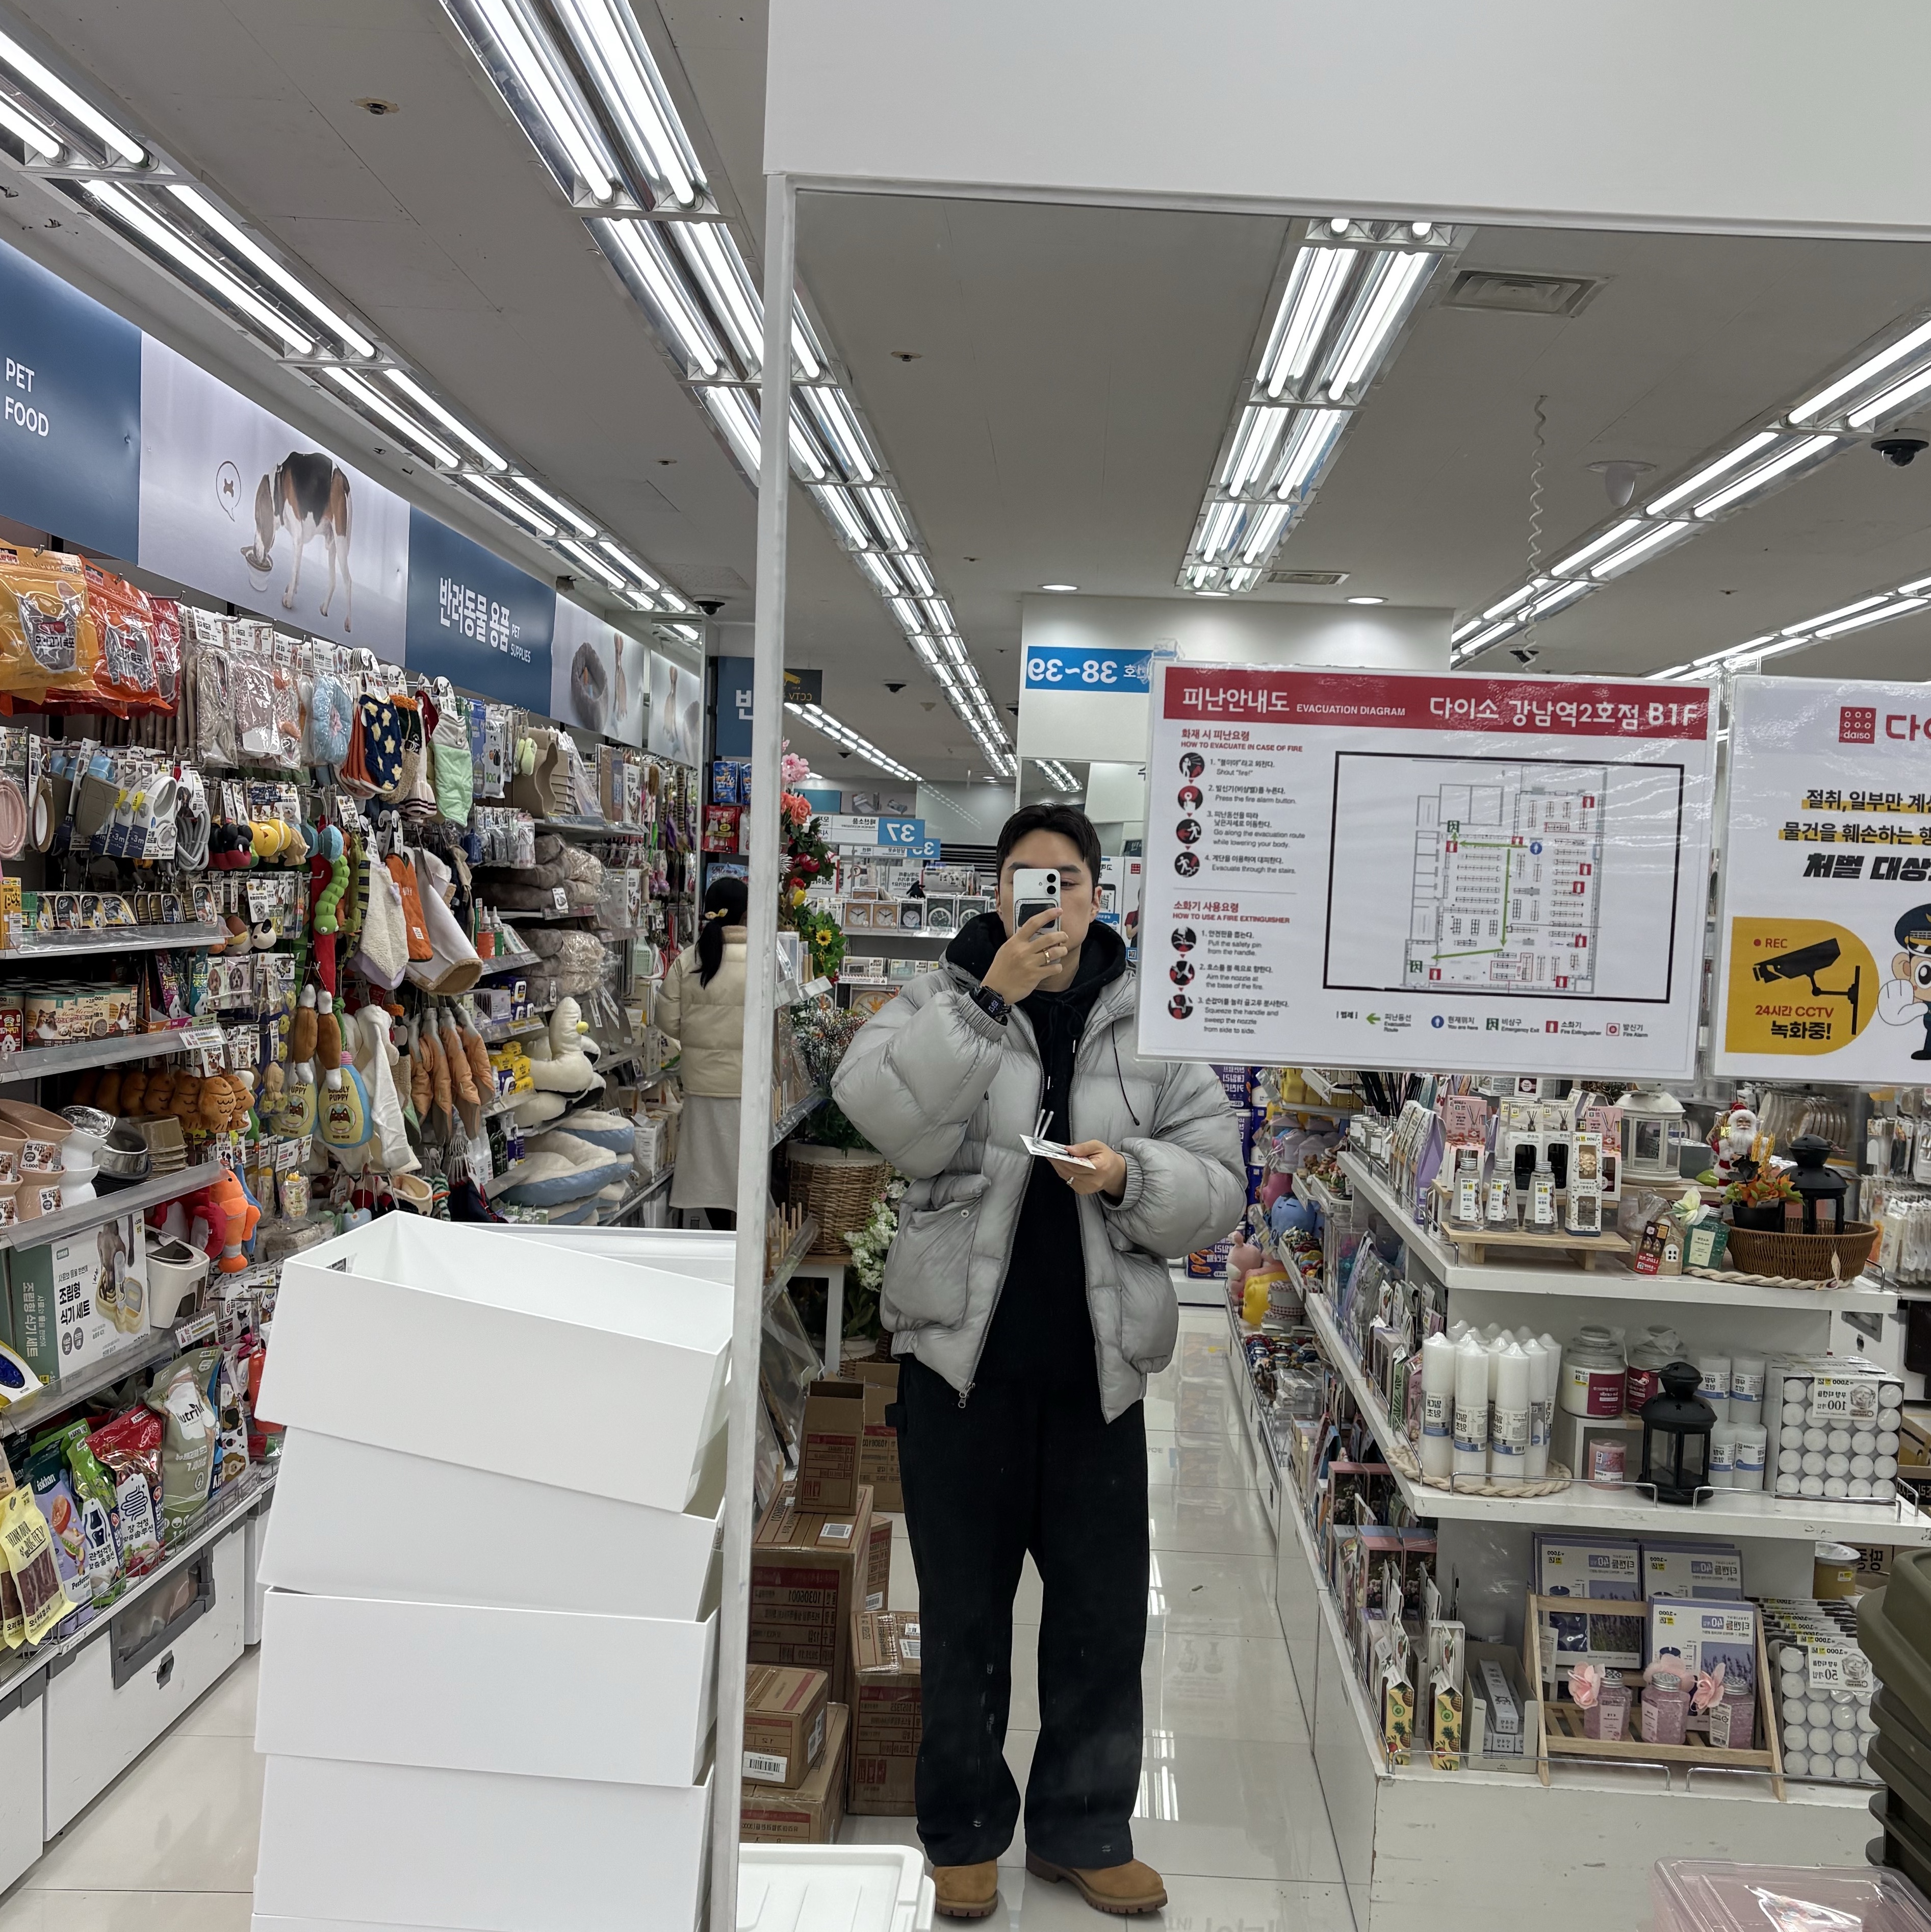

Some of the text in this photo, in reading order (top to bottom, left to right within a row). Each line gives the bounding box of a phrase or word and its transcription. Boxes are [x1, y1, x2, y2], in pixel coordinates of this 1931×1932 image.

[6, 357, 35, 392] PET
[5, 396, 48, 437] FOOD
[440, 577, 509, 652] 반려동물 용품
[510, 644, 530, 663] SUPPLIES
[1182, 687, 1698, 730] 피난안내도 EVACUATION DIAGRAM 다이소 강남역2호점 B1F
[1182, 729, 1249, 741] 화재 시 피난요령
[1844, 730, 1870, 740] daiso
[1784, 822, 1837, 842] 물건을
[1842, 824, 1914, 845] 훼손하는
[1803, 852, 1931, 882] 처벌 대상
[1173, 901, 1239, 913] 소화기 사용요령
[1765, 938, 1787, 948] REC
[1755, 1005, 1834, 1018] 24시간 CCTV
[1771, 1021, 1832, 1040] 녹화중!
[59, 1281, 81, 1305] 조립형
[23, 1282, 38, 1357] 조립형 식기 세트
[61, 1300, 90, 1325] 식기 세트
[37, 1473, 56, 1492] iskhan
[127, 1518, 149, 1533] 장 걱정
